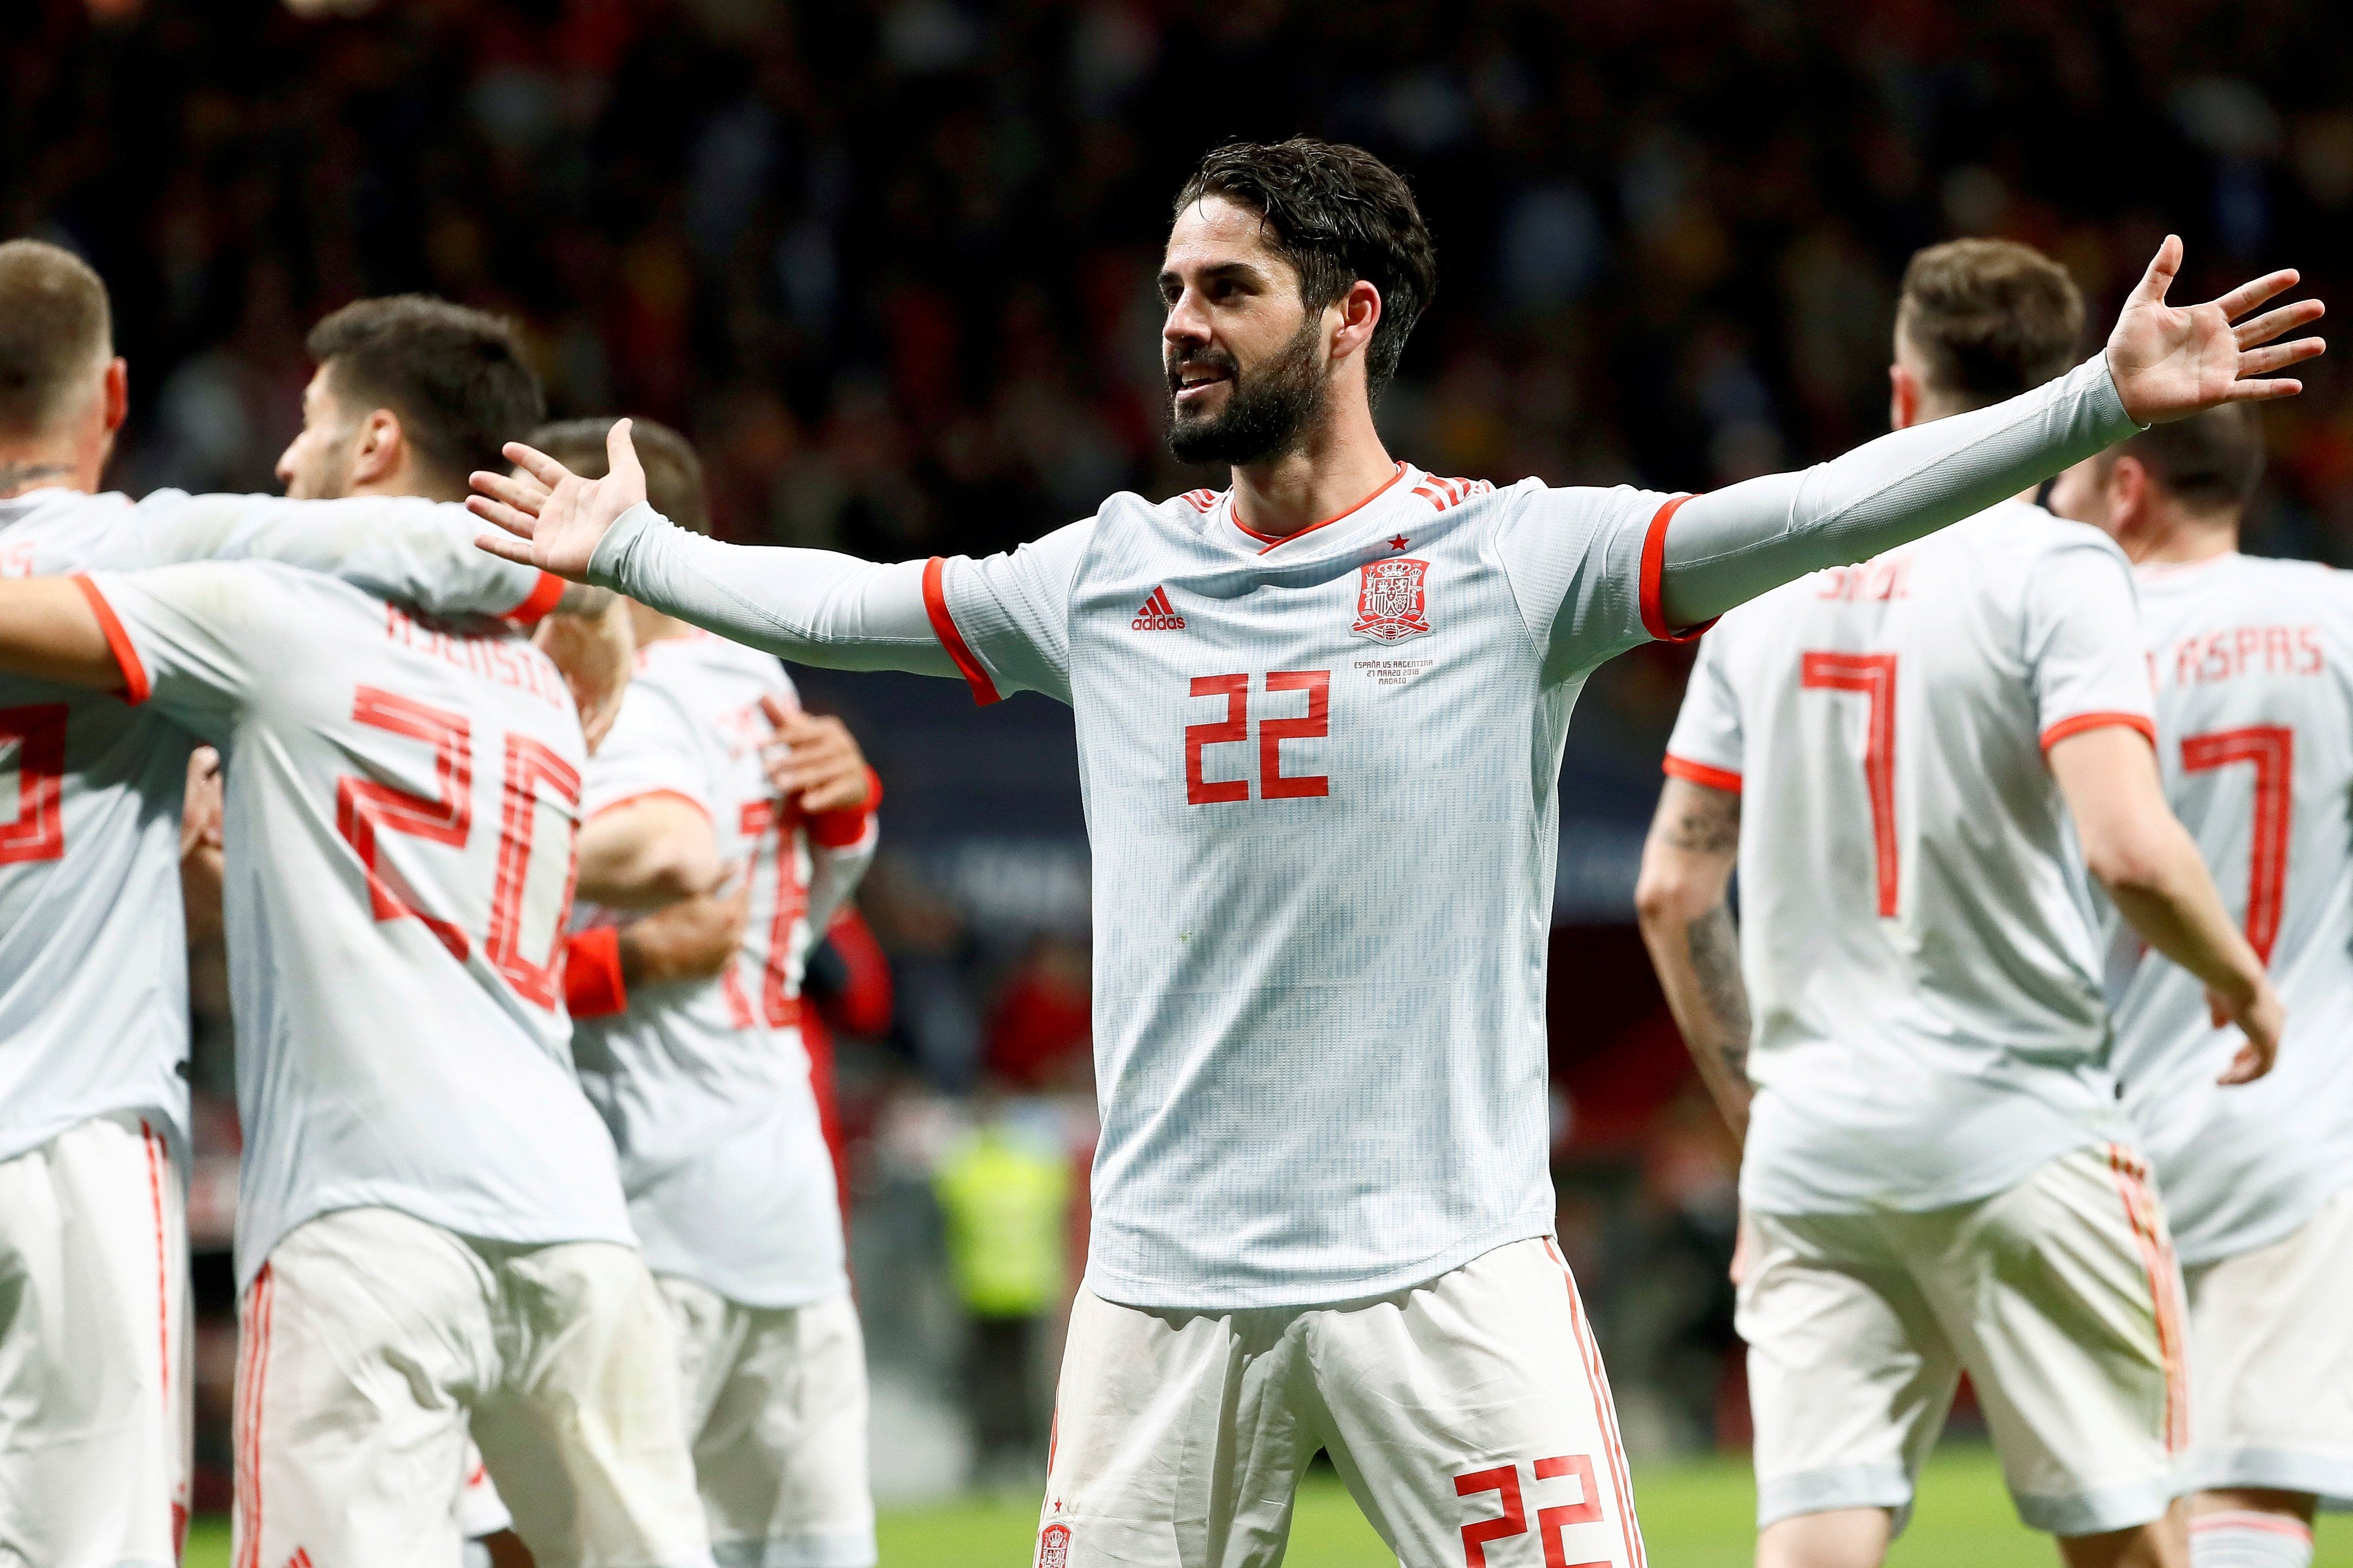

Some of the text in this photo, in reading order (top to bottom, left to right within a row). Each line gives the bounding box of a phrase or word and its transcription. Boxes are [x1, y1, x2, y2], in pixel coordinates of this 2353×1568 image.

[1131, 614, 1185, 630] adidas
[1354, 660, 1380, 668] ESPAÑA
[1393, 660, 1433, 668] ARGENTINA
[1185, 669, 1331, 806] 22
[1801, 652, 1900, 916] 7
[335, 684, 581, 1014] 20
[1453, 1454, 1615, 1568] 22
